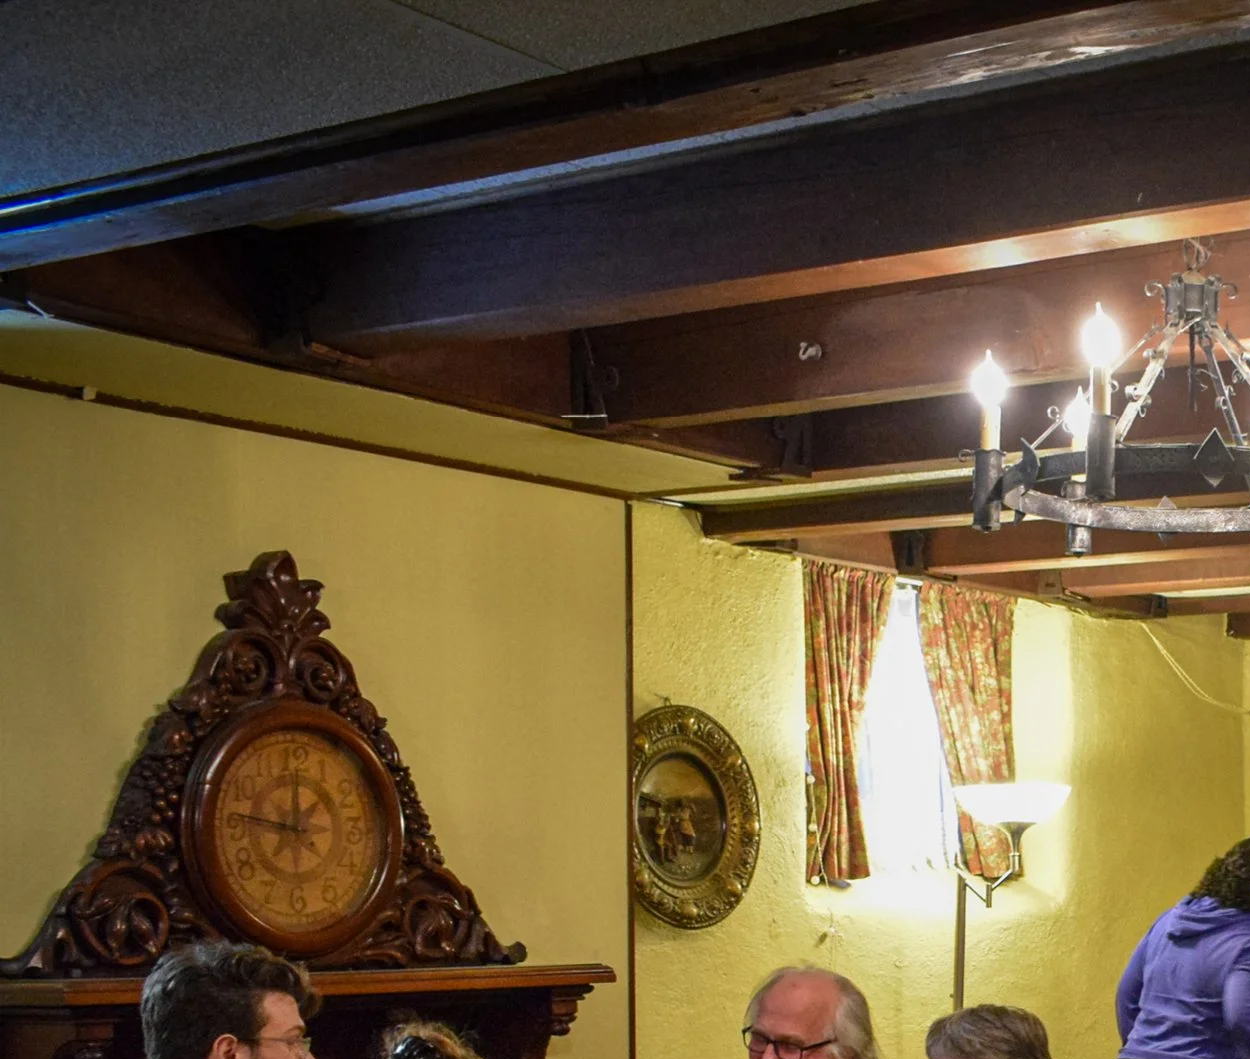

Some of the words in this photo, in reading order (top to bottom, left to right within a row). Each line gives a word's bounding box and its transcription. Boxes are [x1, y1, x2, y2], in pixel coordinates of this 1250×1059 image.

[256, 753, 274, 778] 11
[282, 746, 309, 772] 12
[318, 757, 328, 783] 1
[233, 775, 254, 802] 10
[336, 778, 355, 809] 2
[226, 811, 246, 841] 9
[345, 816, 363, 845] 3
[235, 847, 254, 881] 8
[336, 848, 357, 875] 4
[259, 879, 276, 905] 7
[289, 885, 307, 913] 6
[321, 875, 338, 903] 5
